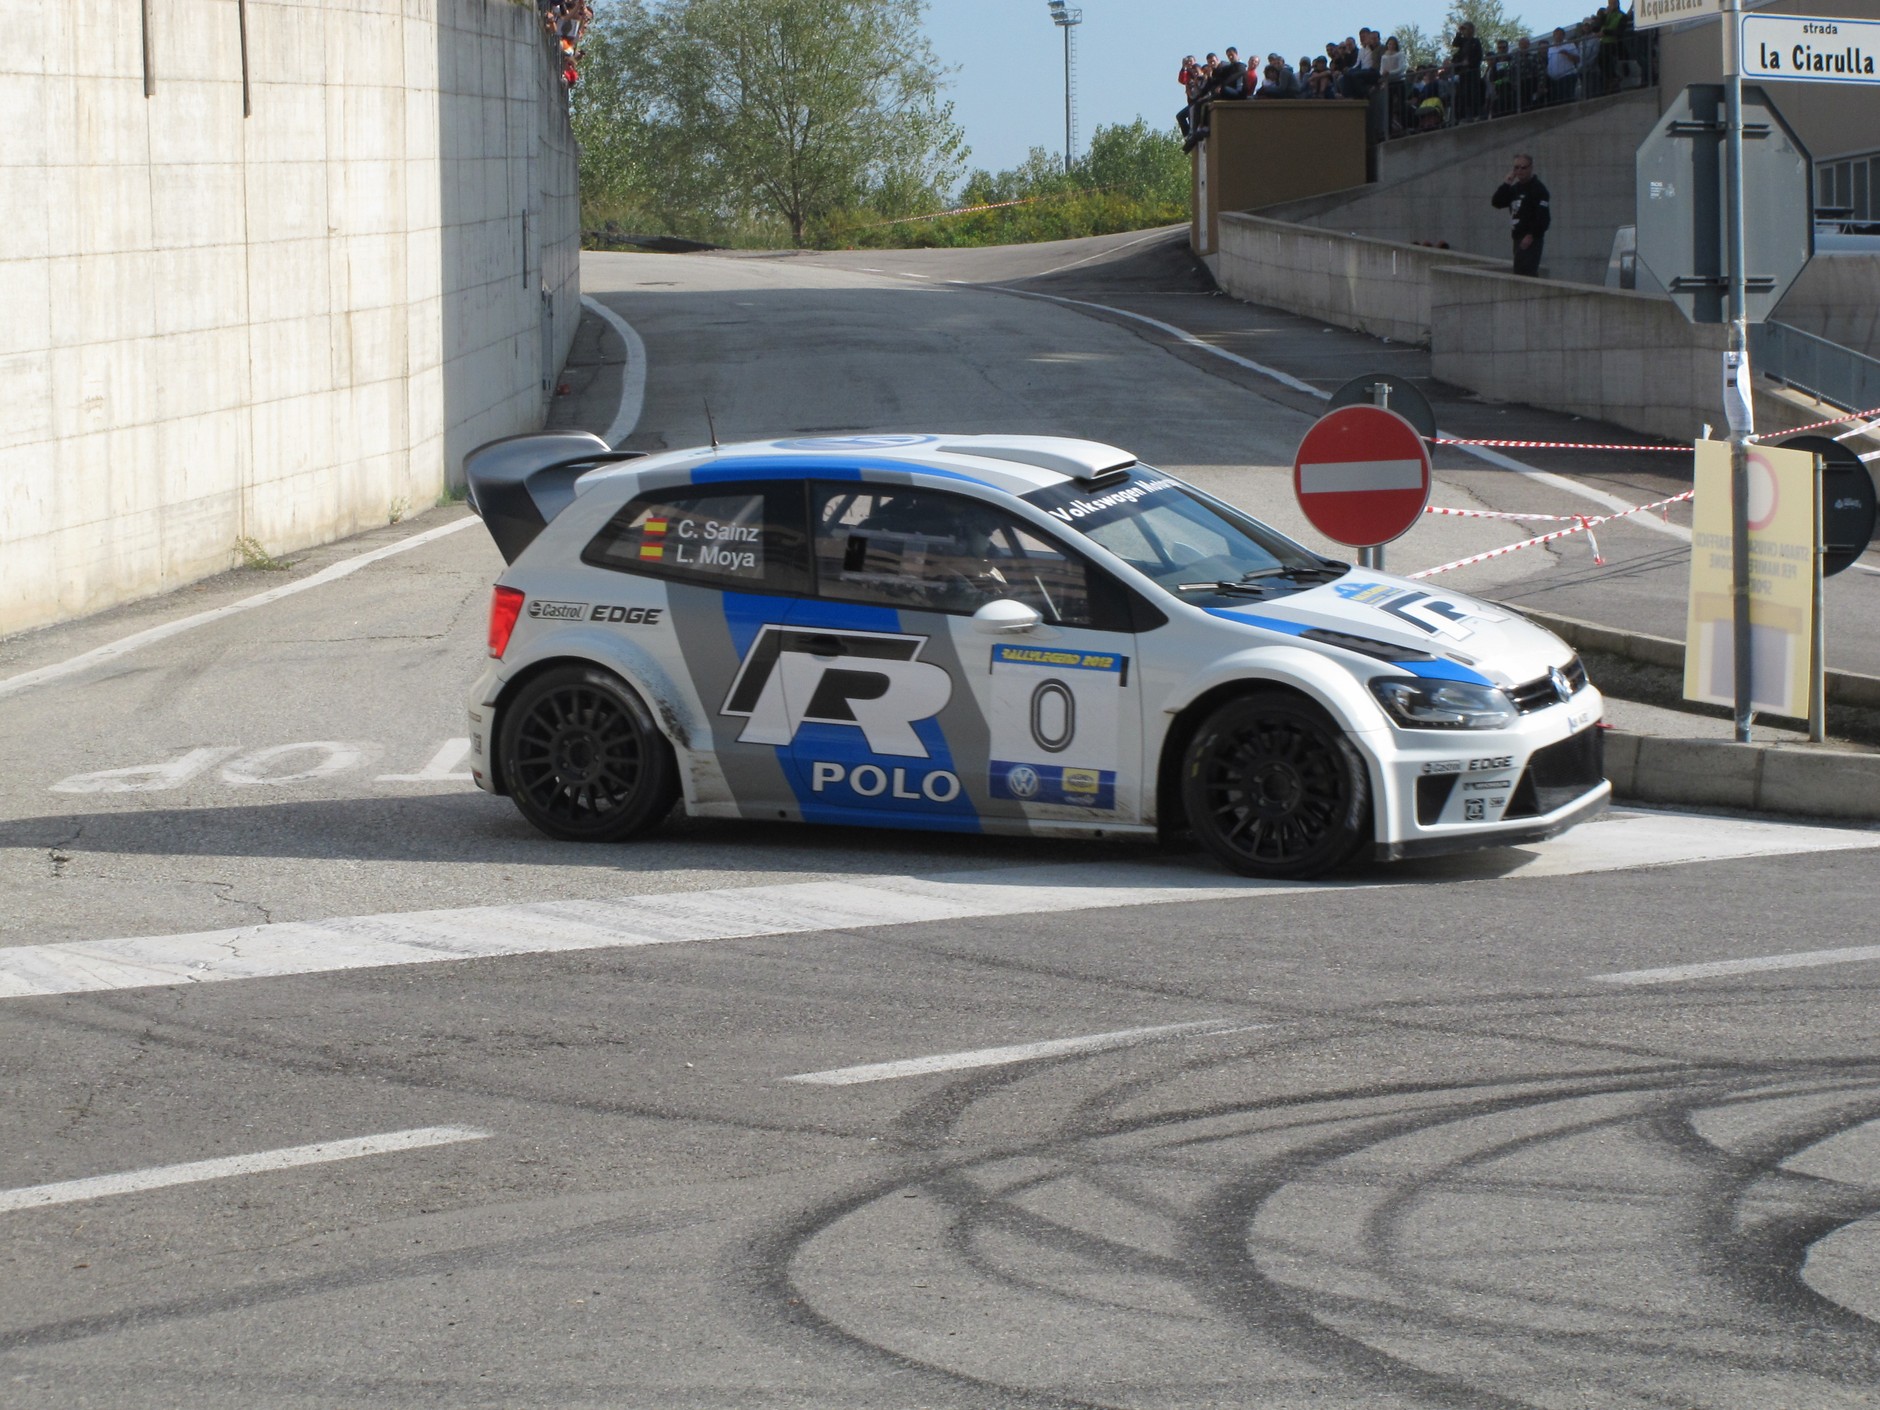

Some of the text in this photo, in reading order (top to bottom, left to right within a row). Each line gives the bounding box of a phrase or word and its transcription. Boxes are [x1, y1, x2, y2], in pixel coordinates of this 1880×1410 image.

[1802, 23, 1838, 35] strada
[1760, 42, 1874, 74] la Ciarulla
[1050, 487, 1147, 522] Volkswagen
[678, 519, 759, 542] C. Sainz
[676, 544, 756, 570] L. Moya
[541, 603, 664, 625] Castrol EDGE
[1030, 678, 1076, 753] 0
[1469, 756, 1513, 771] EDGE
[811, 760, 961, 802] POLO
